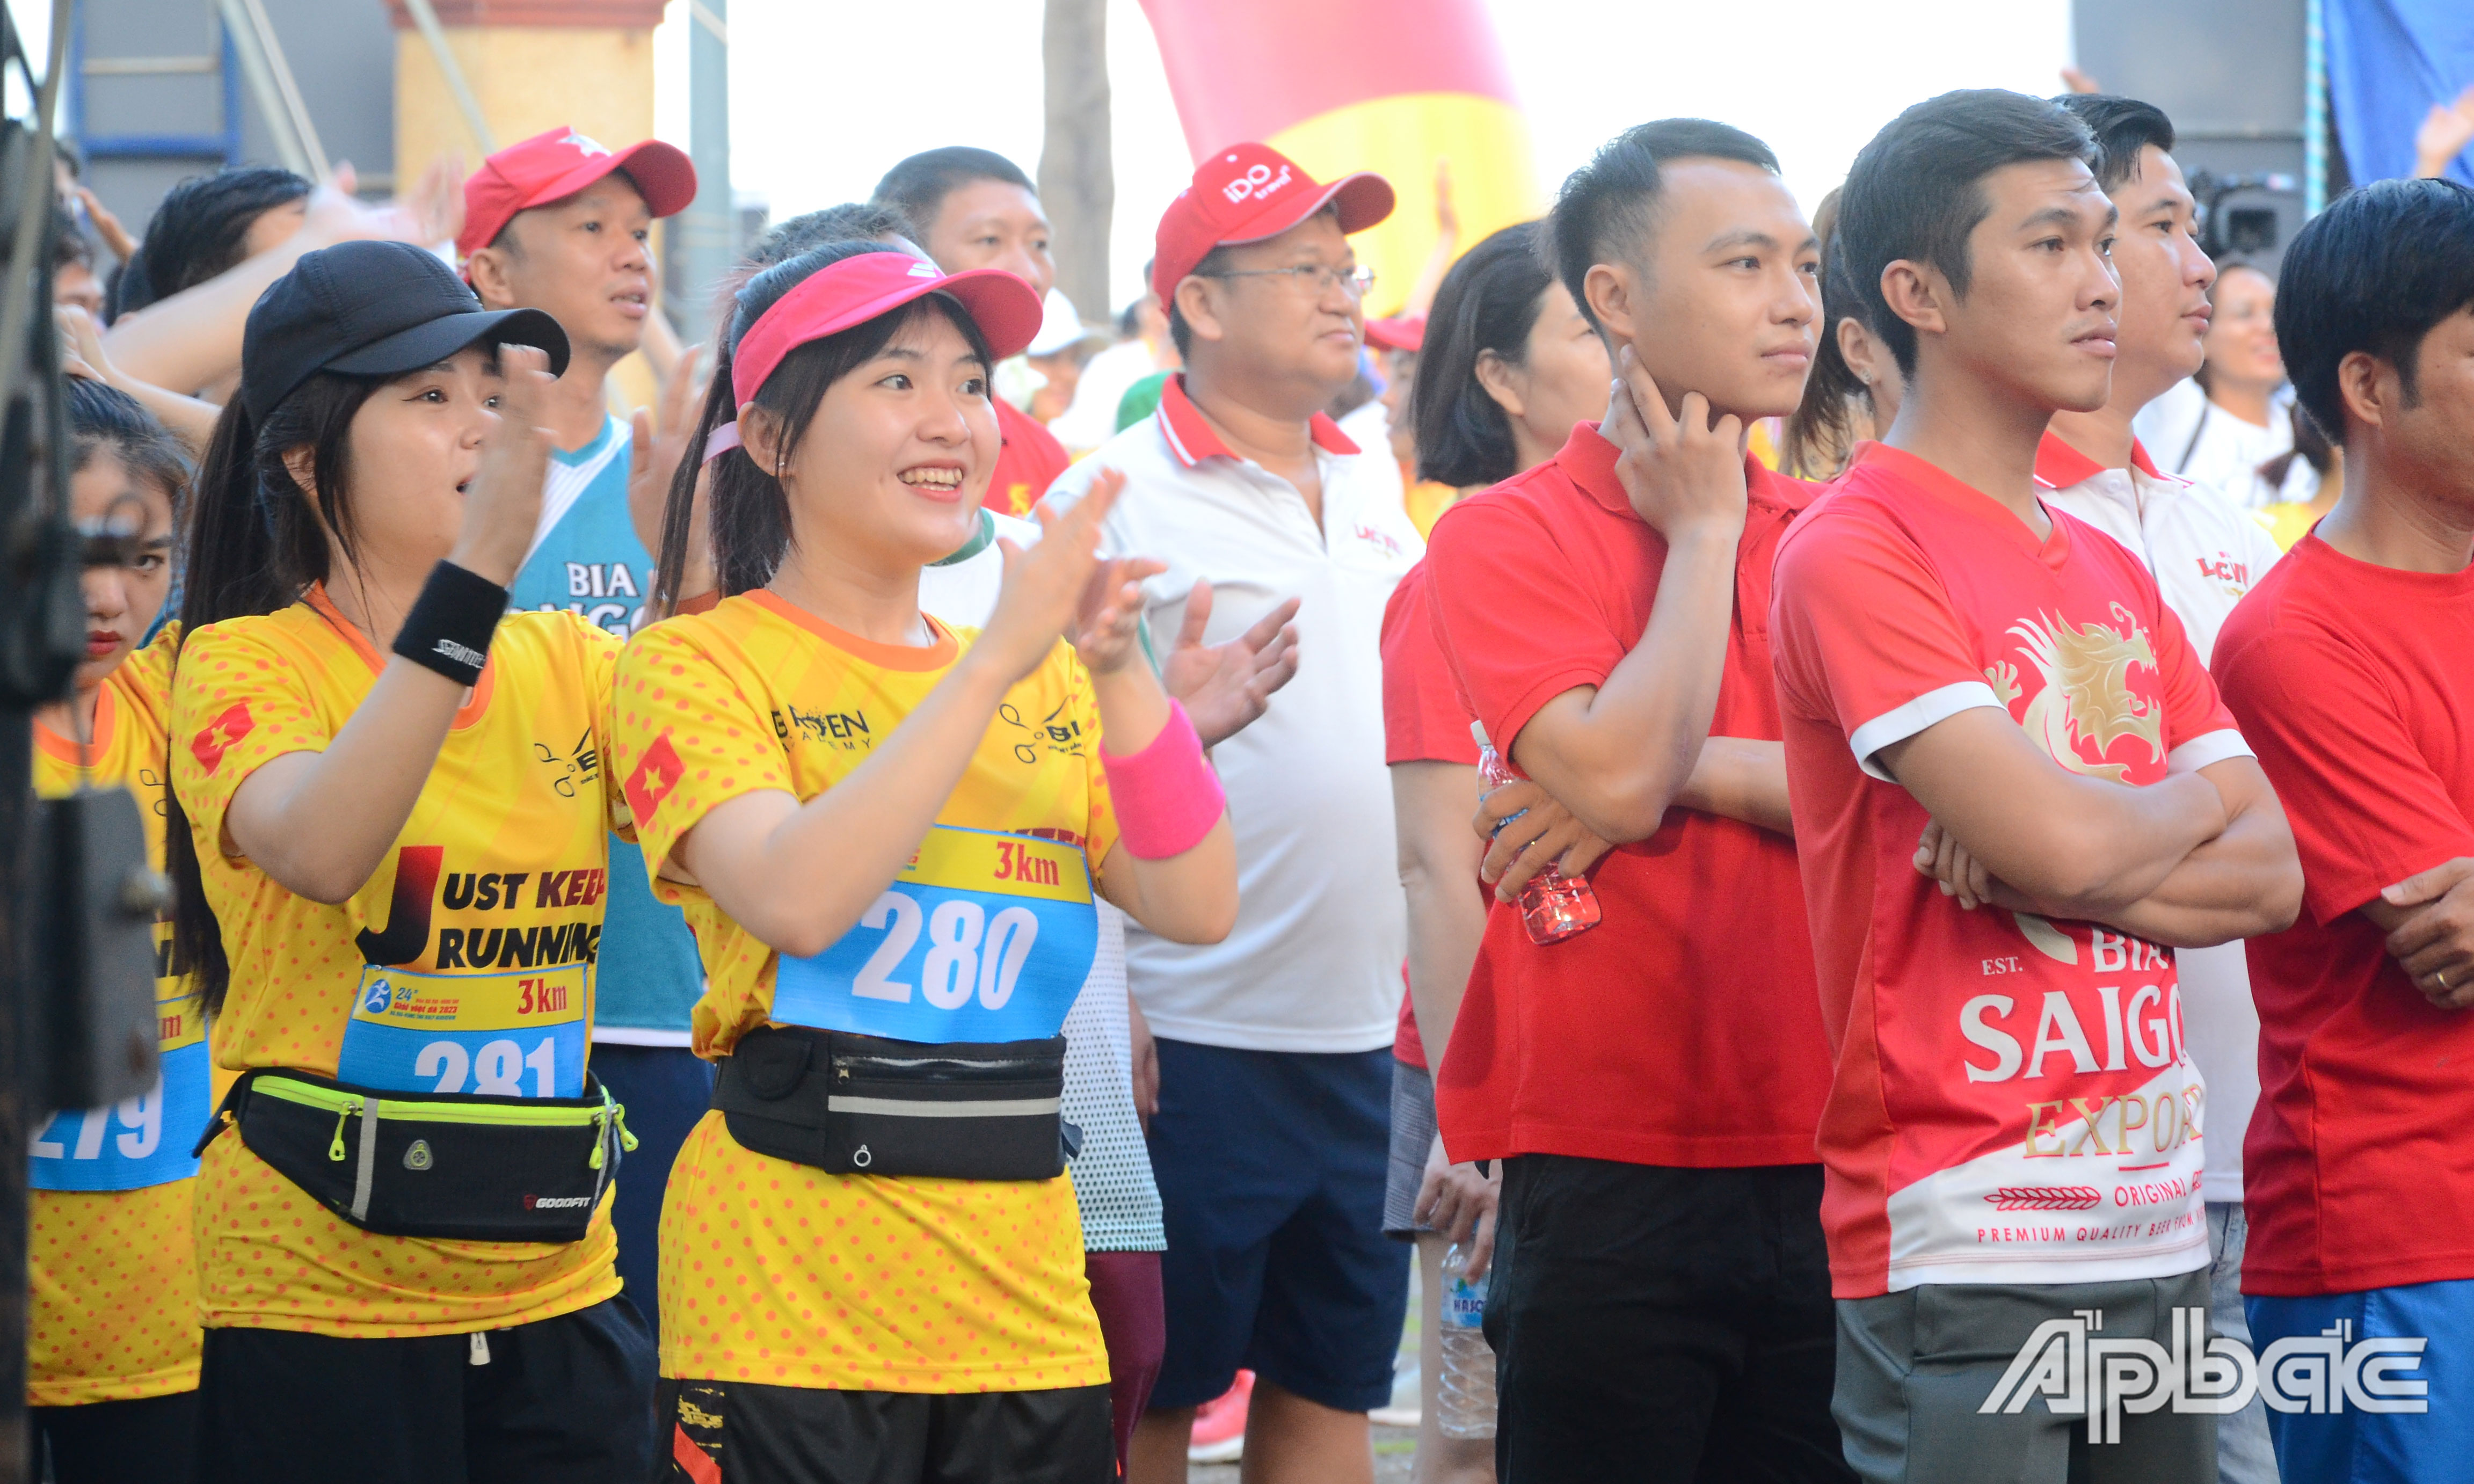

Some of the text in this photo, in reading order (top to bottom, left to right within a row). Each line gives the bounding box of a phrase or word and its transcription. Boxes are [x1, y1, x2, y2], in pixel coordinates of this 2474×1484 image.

[565, 562, 639, 598] BIA
[993, 841, 1060, 886] 3km
[852, 890, 1039, 1010] 280
[1982, 956, 2024, 976] EST.
[2092, 927, 2169, 973] BIA
[517, 978, 567, 1015] 3km
[535, 1197, 591, 1208] GOODFIT
[2114, 1177, 2187, 1207] ORIGINAL
[1977, 1227, 2066, 1243] PREMIUM
[2077, 1224, 2141, 1242] QUALITY
